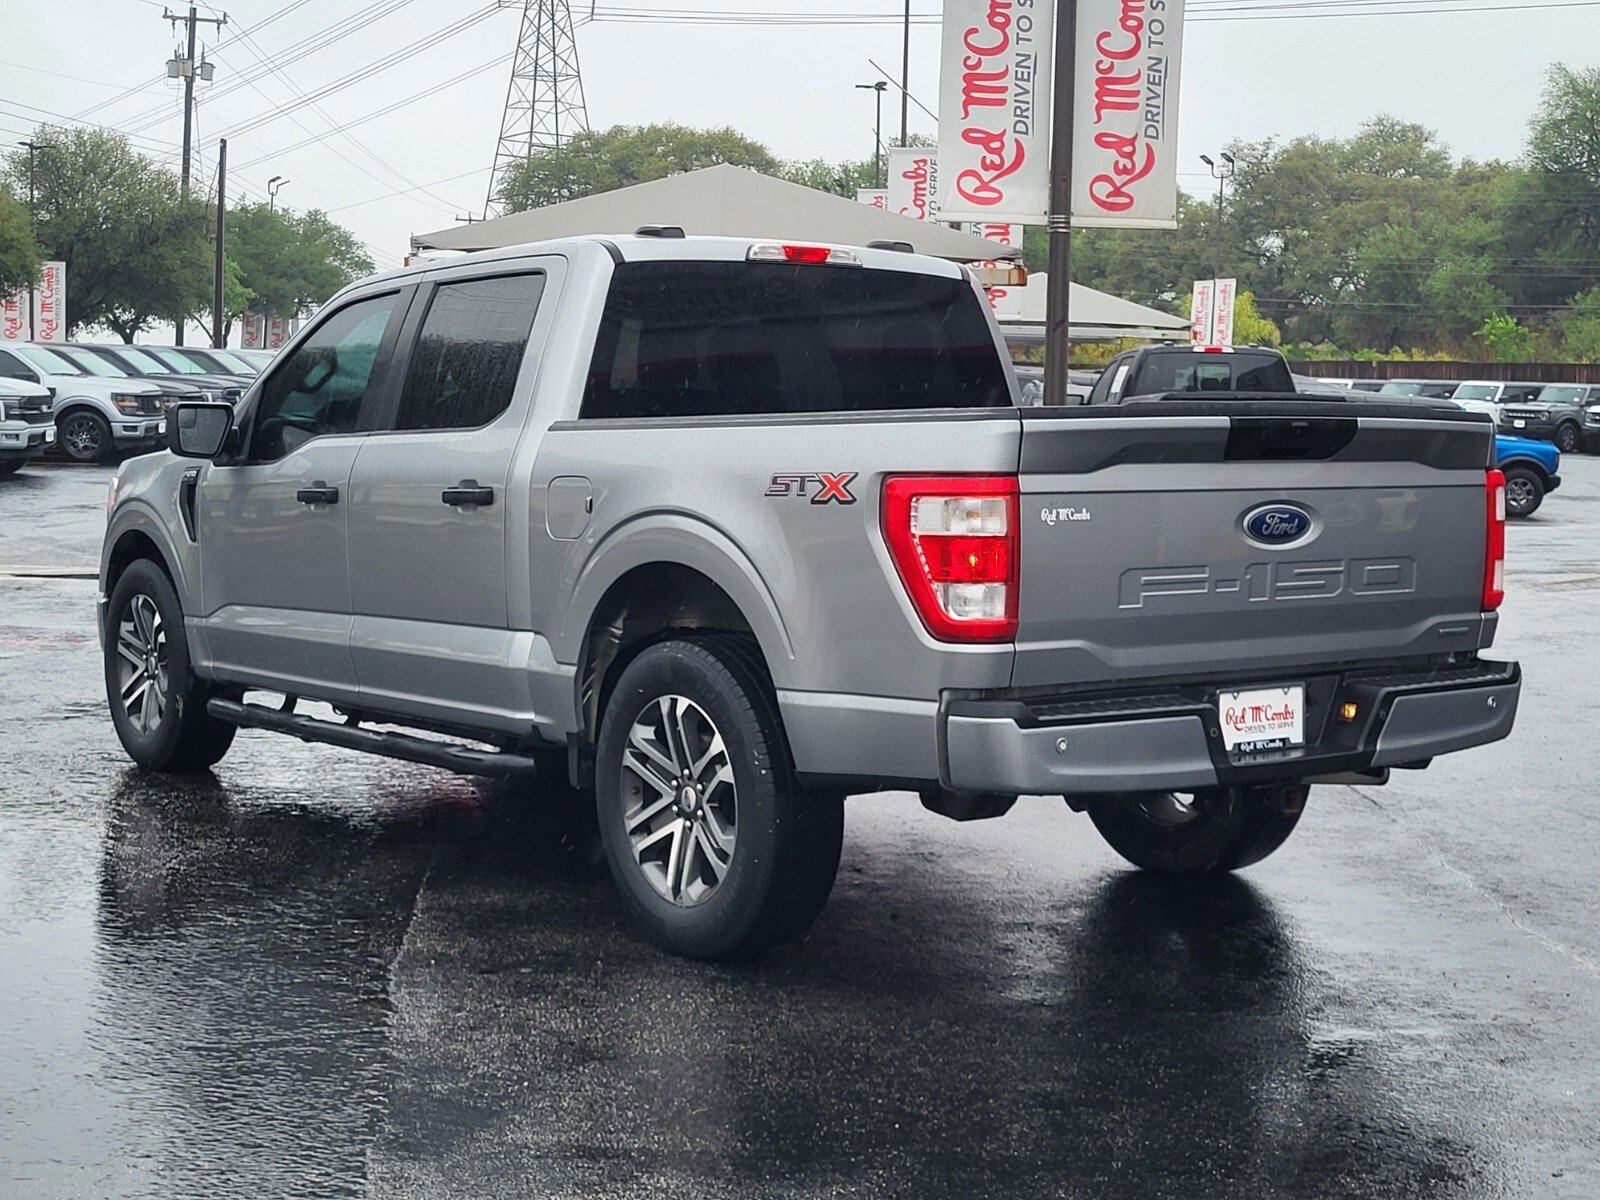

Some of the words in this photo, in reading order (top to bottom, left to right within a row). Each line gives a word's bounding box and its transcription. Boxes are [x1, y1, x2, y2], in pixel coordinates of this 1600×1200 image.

[1015, 14, 1033, 46] TO
[1147, 18, 1165, 49] TO
[1012, 52, 1032, 136] DRIVEN
[1143, 55, 1164, 141] DRIVEN
[956, 127, 1026, 206] Red
[1089, 132, 1156, 212] Red
[928, 200, 938, 218] TO
[40, 266, 54, 316] McCombs
[4, 316, 23, 339] Red
[40, 317, 59, 340] Red
[764, 472, 859, 505] STX
[1041, 507, 1057, 526] Red
[1262, 512, 1299, 535] Ford
[1118, 555, 1417, 609] F-150
[1225, 706, 1247, 732] Red
[1249, 703, 1294, 723] McCombs
[1244, 723, 1266, 733] DRIVEN
[1267, 722, 1276, 731] TO
[1277, 721, 1294, 730] SERVE
